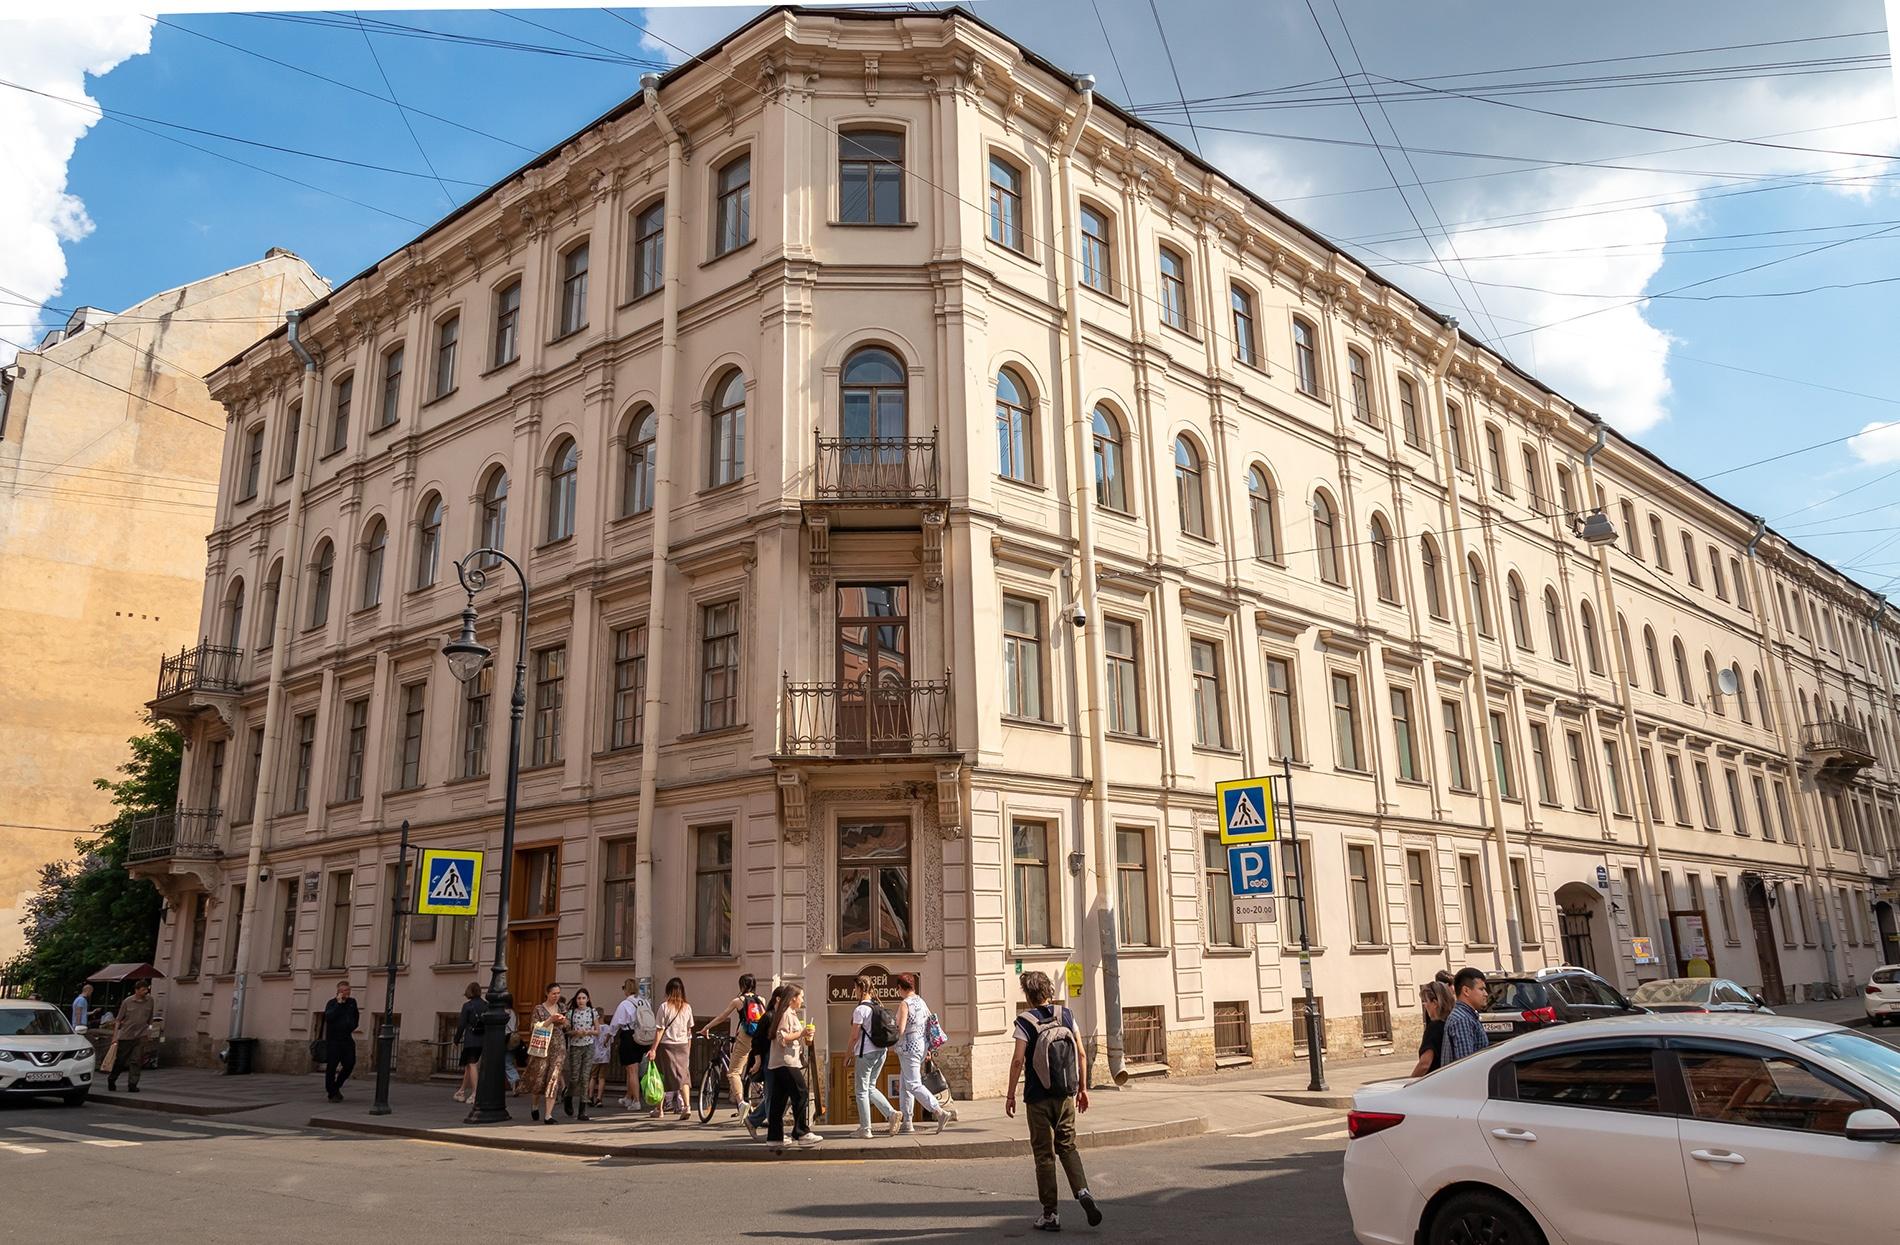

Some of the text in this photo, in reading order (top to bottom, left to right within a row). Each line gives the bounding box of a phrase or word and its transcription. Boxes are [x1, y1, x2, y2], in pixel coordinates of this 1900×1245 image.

[1240, 852, 1263, 889] P
[1236, 906, 1272, 914] 8.00-20.00
[832, 988, 850, 998] Ф.М.
